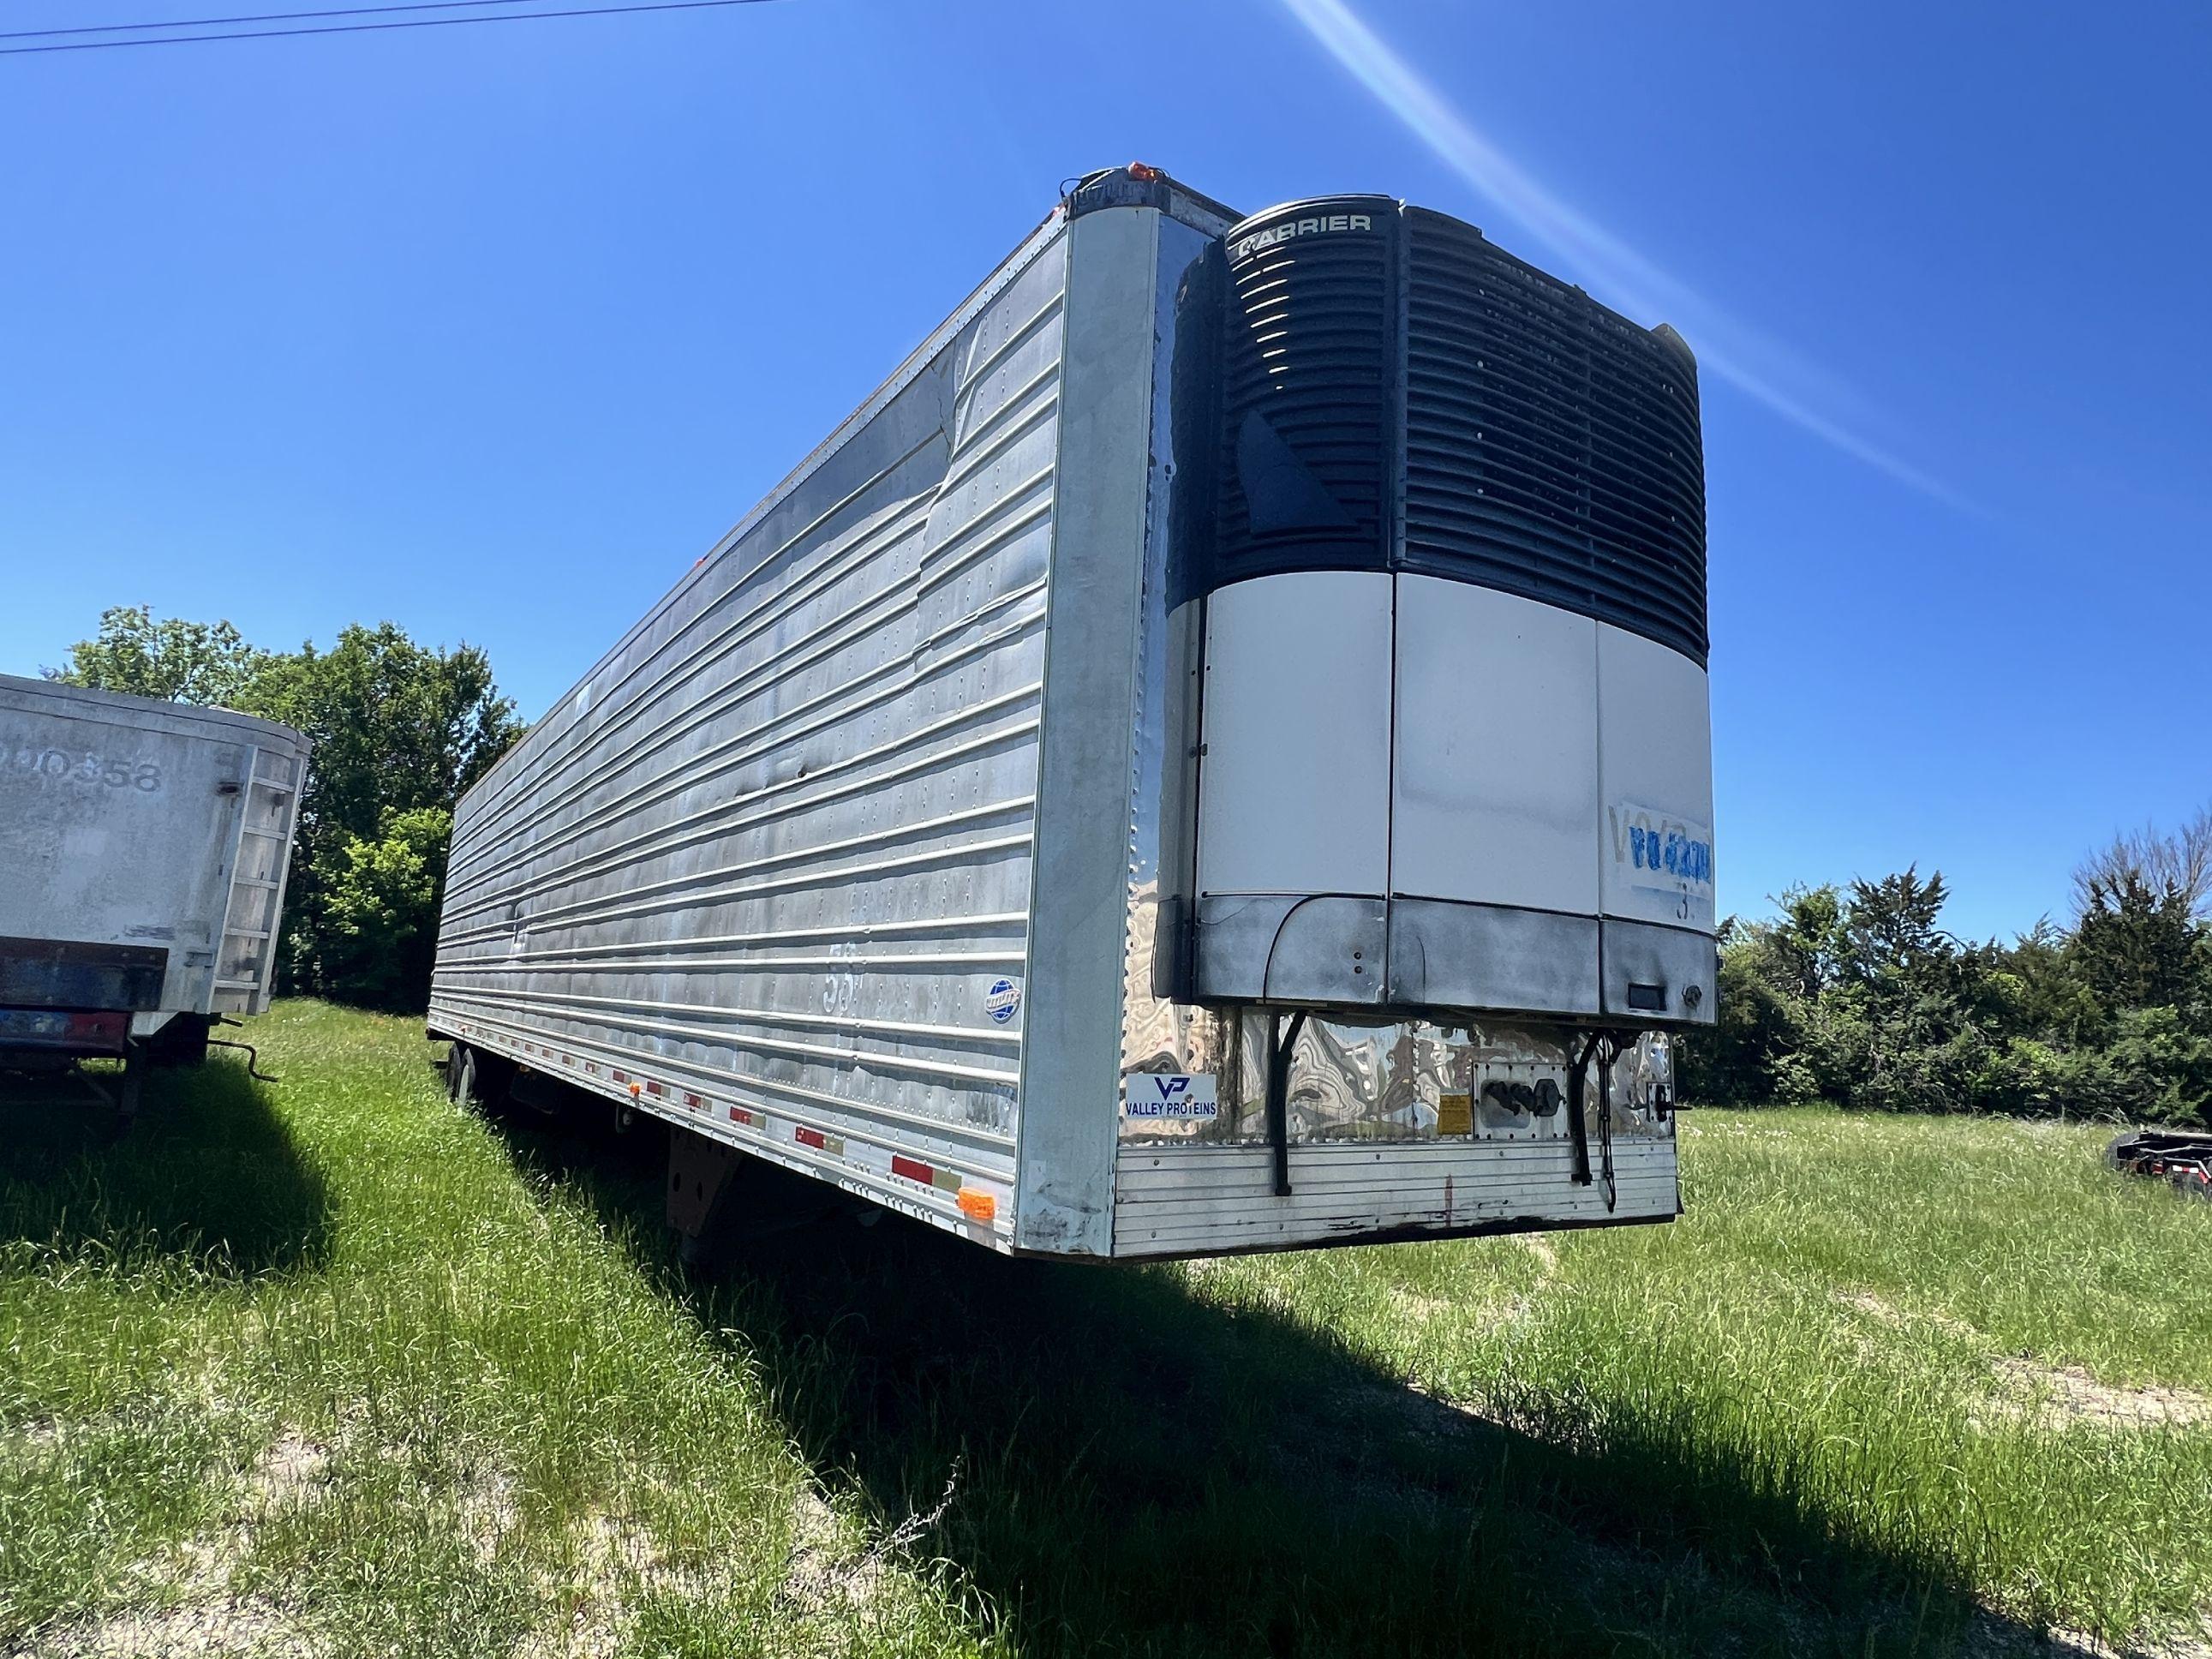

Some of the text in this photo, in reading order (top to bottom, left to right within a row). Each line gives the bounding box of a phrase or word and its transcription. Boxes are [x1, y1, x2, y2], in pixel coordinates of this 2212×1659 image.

[1237, 215, 1371, 258] CARRIER
[1154, 1076, 1190, 1101] VP
[1126, 1102, 1163, 1116] VALLEY
